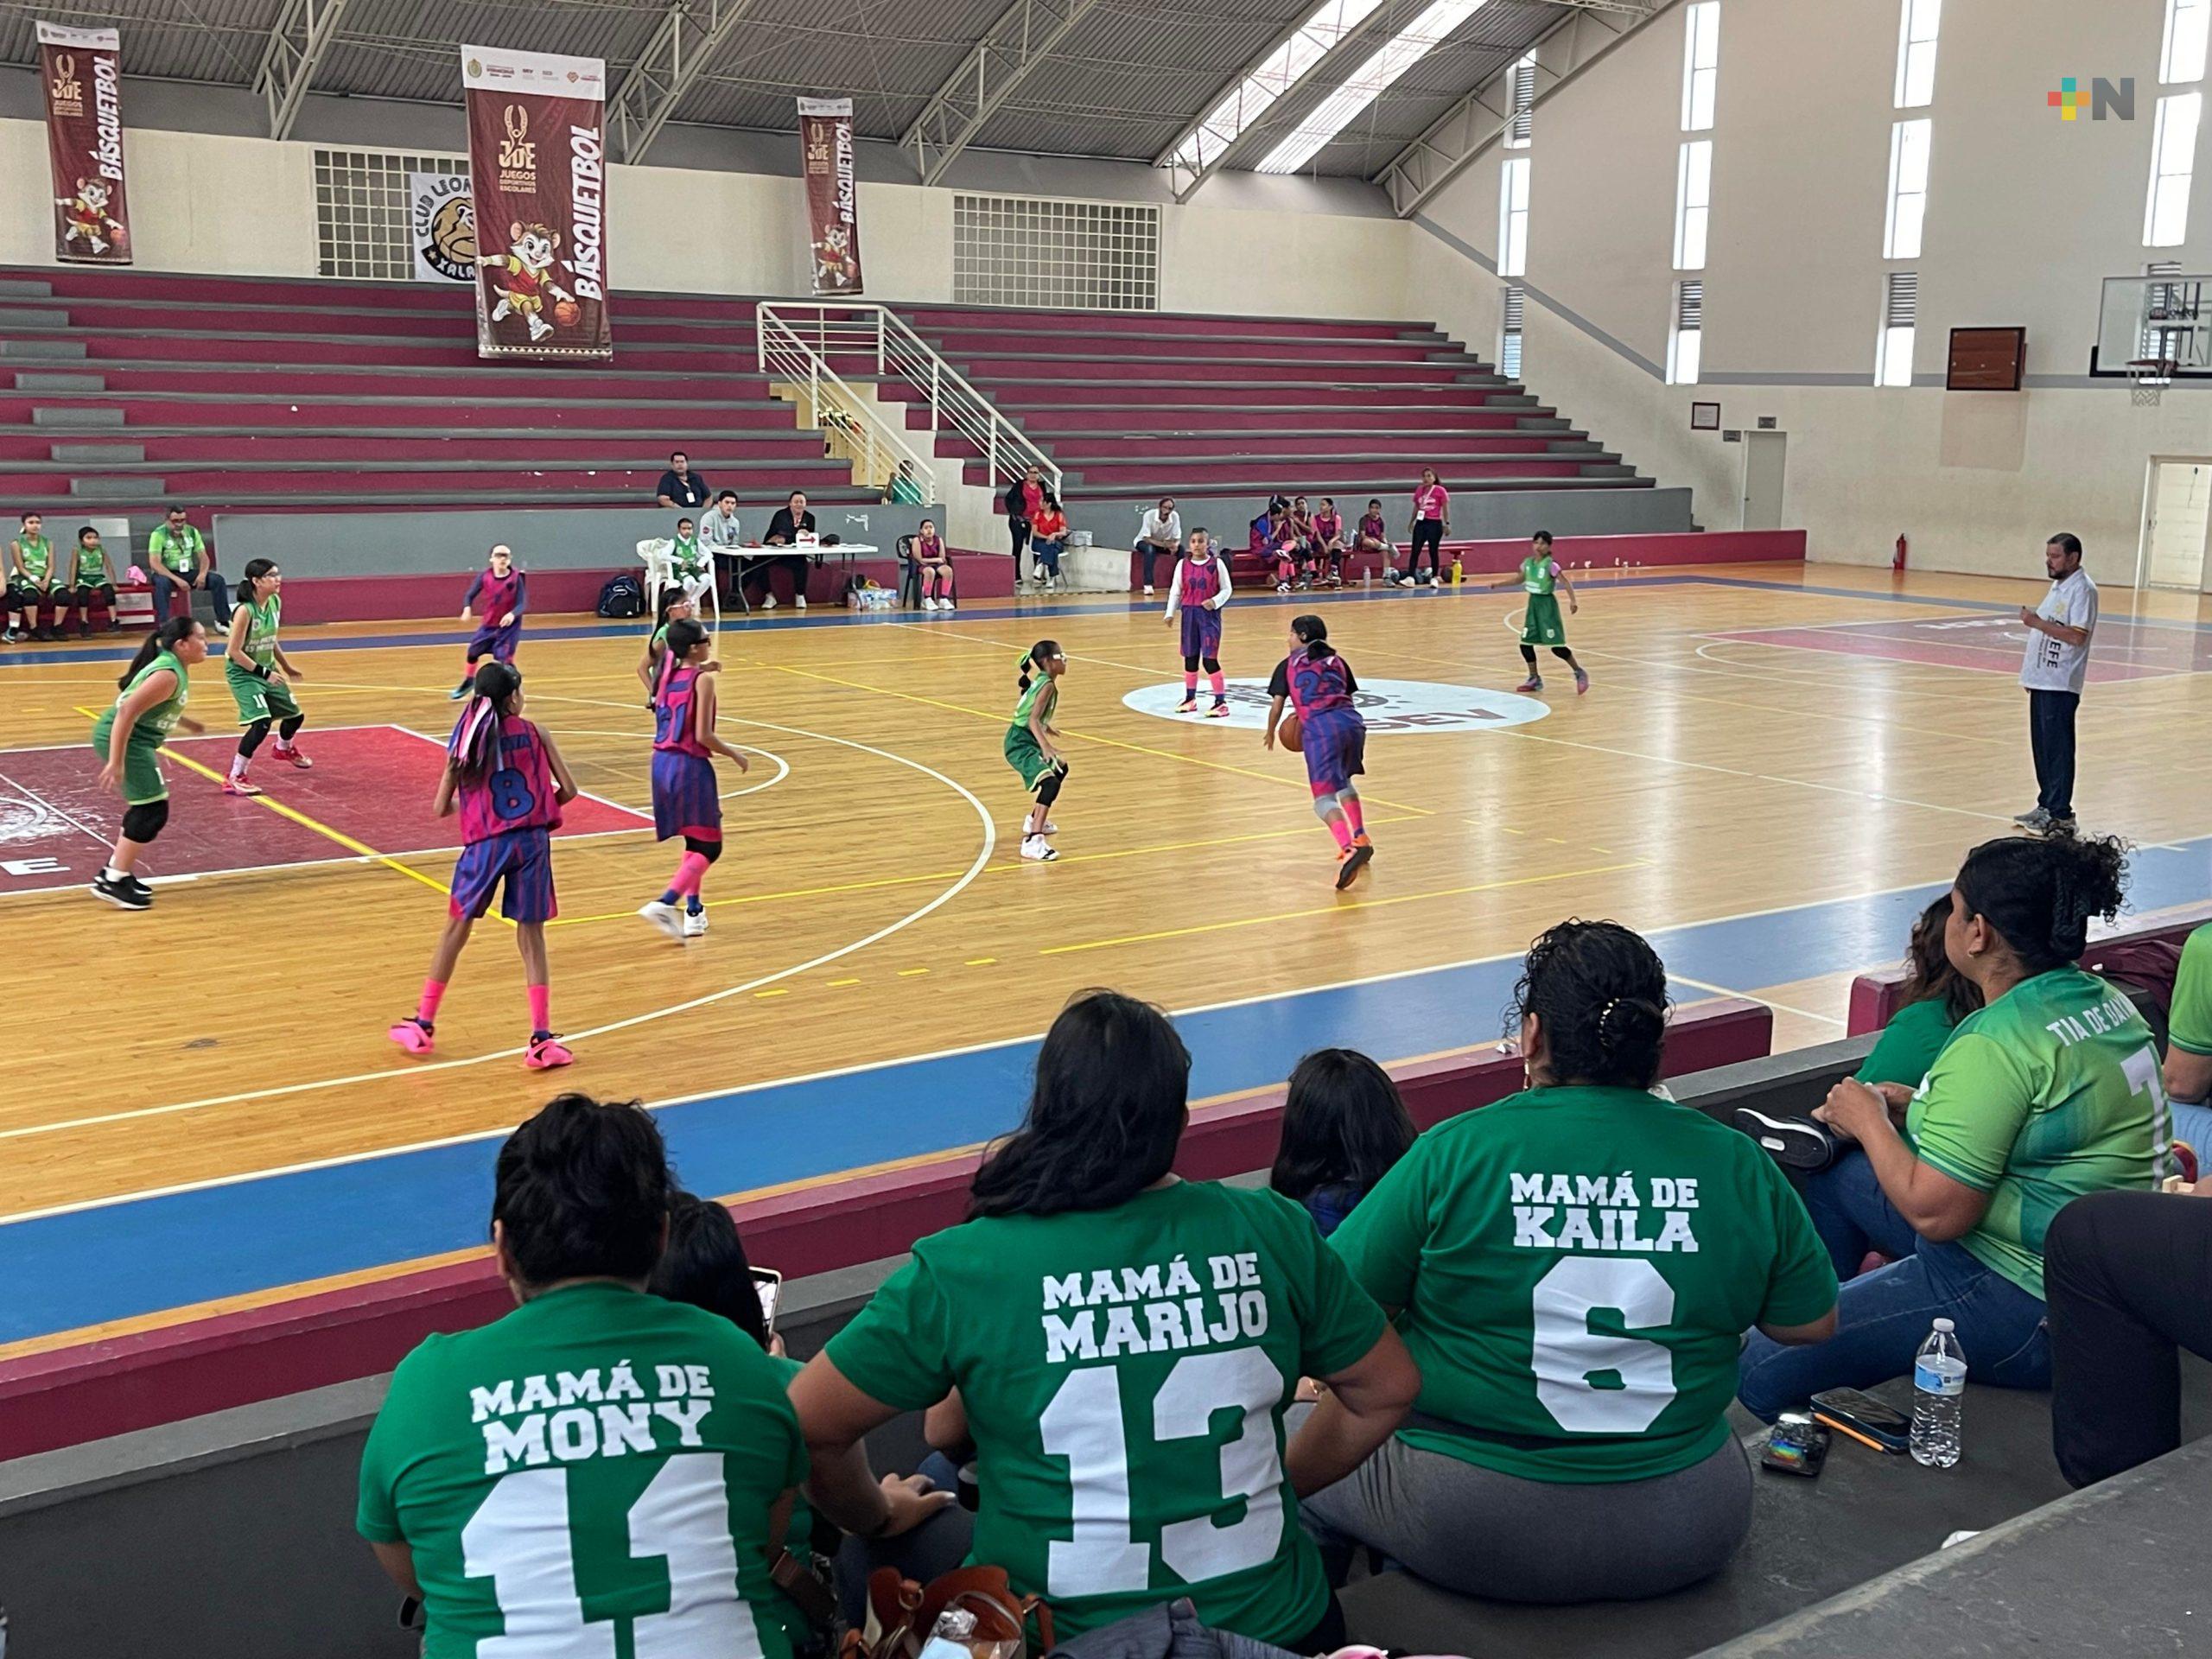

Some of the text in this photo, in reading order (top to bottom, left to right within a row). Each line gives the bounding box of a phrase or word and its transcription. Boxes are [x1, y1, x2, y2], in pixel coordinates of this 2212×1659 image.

[88, 55, 124, 181] BÁSQUETBOL
[499, 140, 537, 169] JDE
[499, 169, 537, 181] JUEGOS
[561, 124, 603, 302] BÁSQUETBOL
[488, 766, 537, 822] 8
[2045, 1015, 2091, 1047] TIA
[2082, 1006, 2112, 1035] DE
[2120, 1045, 2167, 1191] 7
[1510, 1170, 1700, 1209] MAMÁ DE
[1512, 1206, 1700, 1253] KAILA
[1042, 1252, 1262, 1311] MAMÁ DE
[1041, 1289, 1268, 1363] MARIJO
[1530, 1255, 1678, 1433] 6
[469, 1359, 716, 1423] MAMÁ DE
[480, 1399, 713, 1476] MONY
[1039, 1345, 1286, 1598] 13
[461, 1452, 764, 1659] 11
